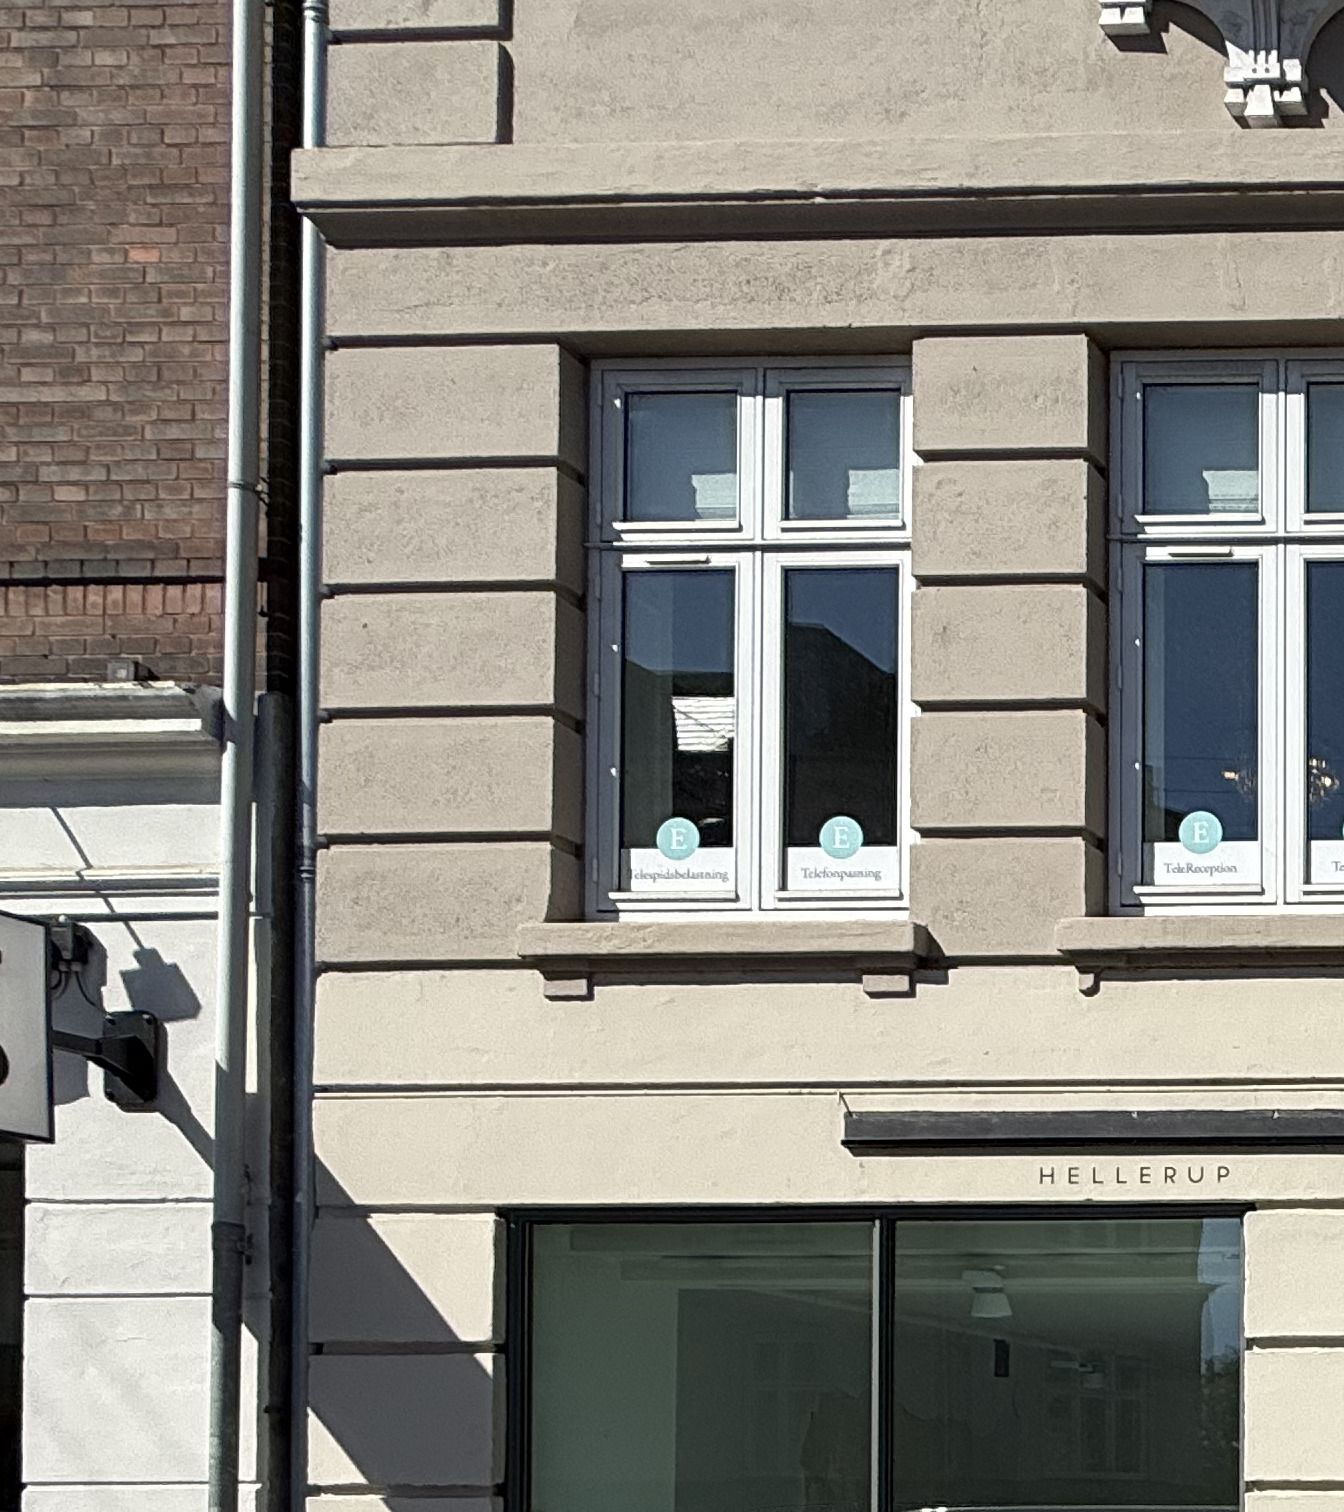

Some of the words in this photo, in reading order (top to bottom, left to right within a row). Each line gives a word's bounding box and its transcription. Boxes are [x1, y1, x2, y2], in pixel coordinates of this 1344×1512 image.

[671, 828, 688, 850] E
[832, 826, 850, 849] E
[1192, 821, 1210, 844] E
[1163, 862, 1239, 877] TeleReception
[1039, 1166, 1231, 1185] HELLERUP
